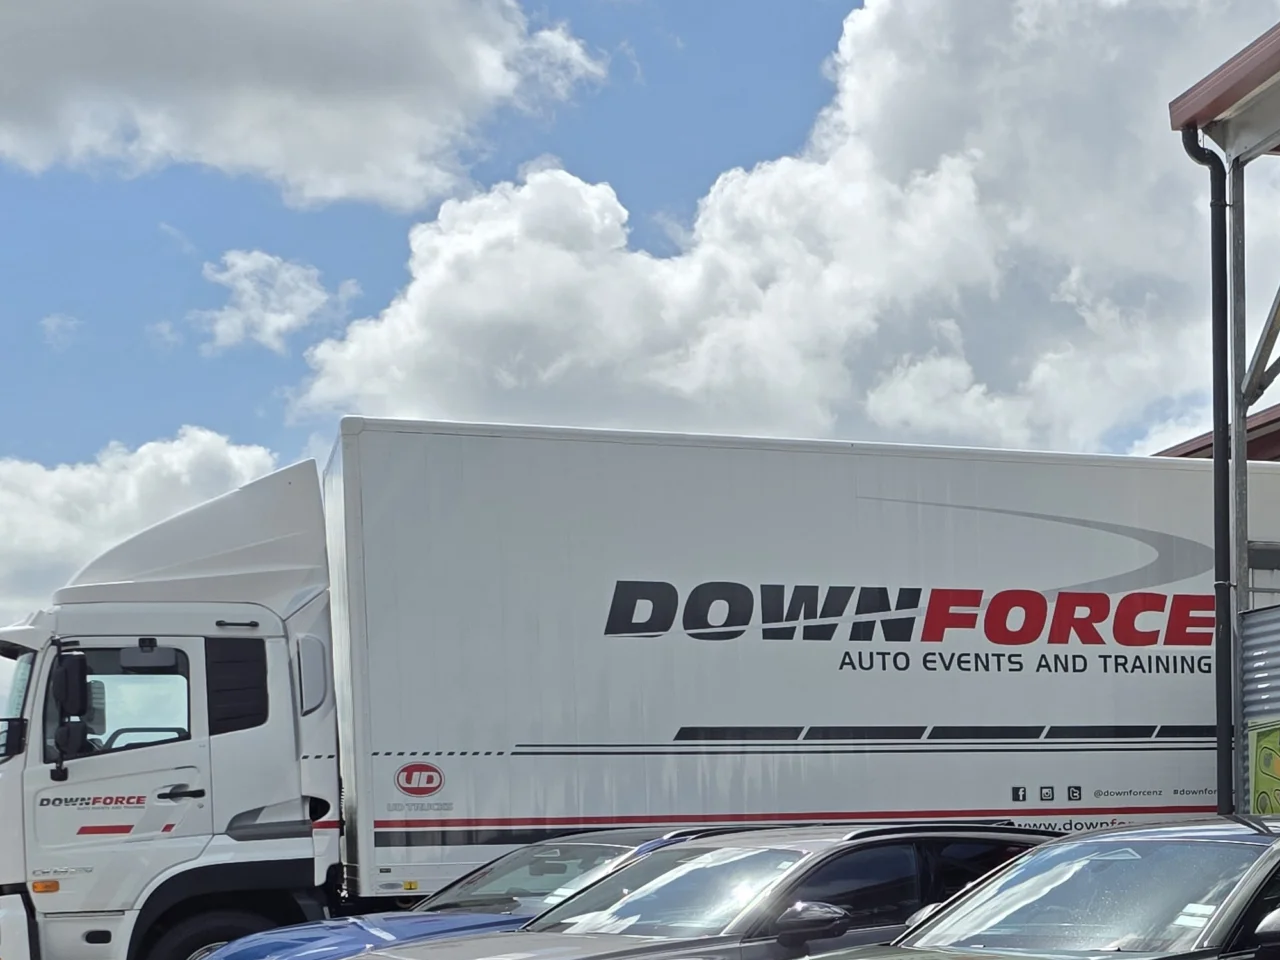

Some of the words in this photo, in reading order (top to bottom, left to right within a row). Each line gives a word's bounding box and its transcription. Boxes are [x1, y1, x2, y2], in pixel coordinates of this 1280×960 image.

[604, 580, 1215, 647] DOWNFORCE
[838, 650, 911, 672] AUTO
[921, 652, 1024, 674] EVENTS
[1035, 653, 1088, 674] AND
[1101, 654, 1212, 675] TRAINING
[398, 771, 441, 788] UD
[39, 795, 147, 807] DOWNFORCE
[1093, 789, 1163, 799] @downforcenz
[1173, 787, 1217, 796] #downfor
